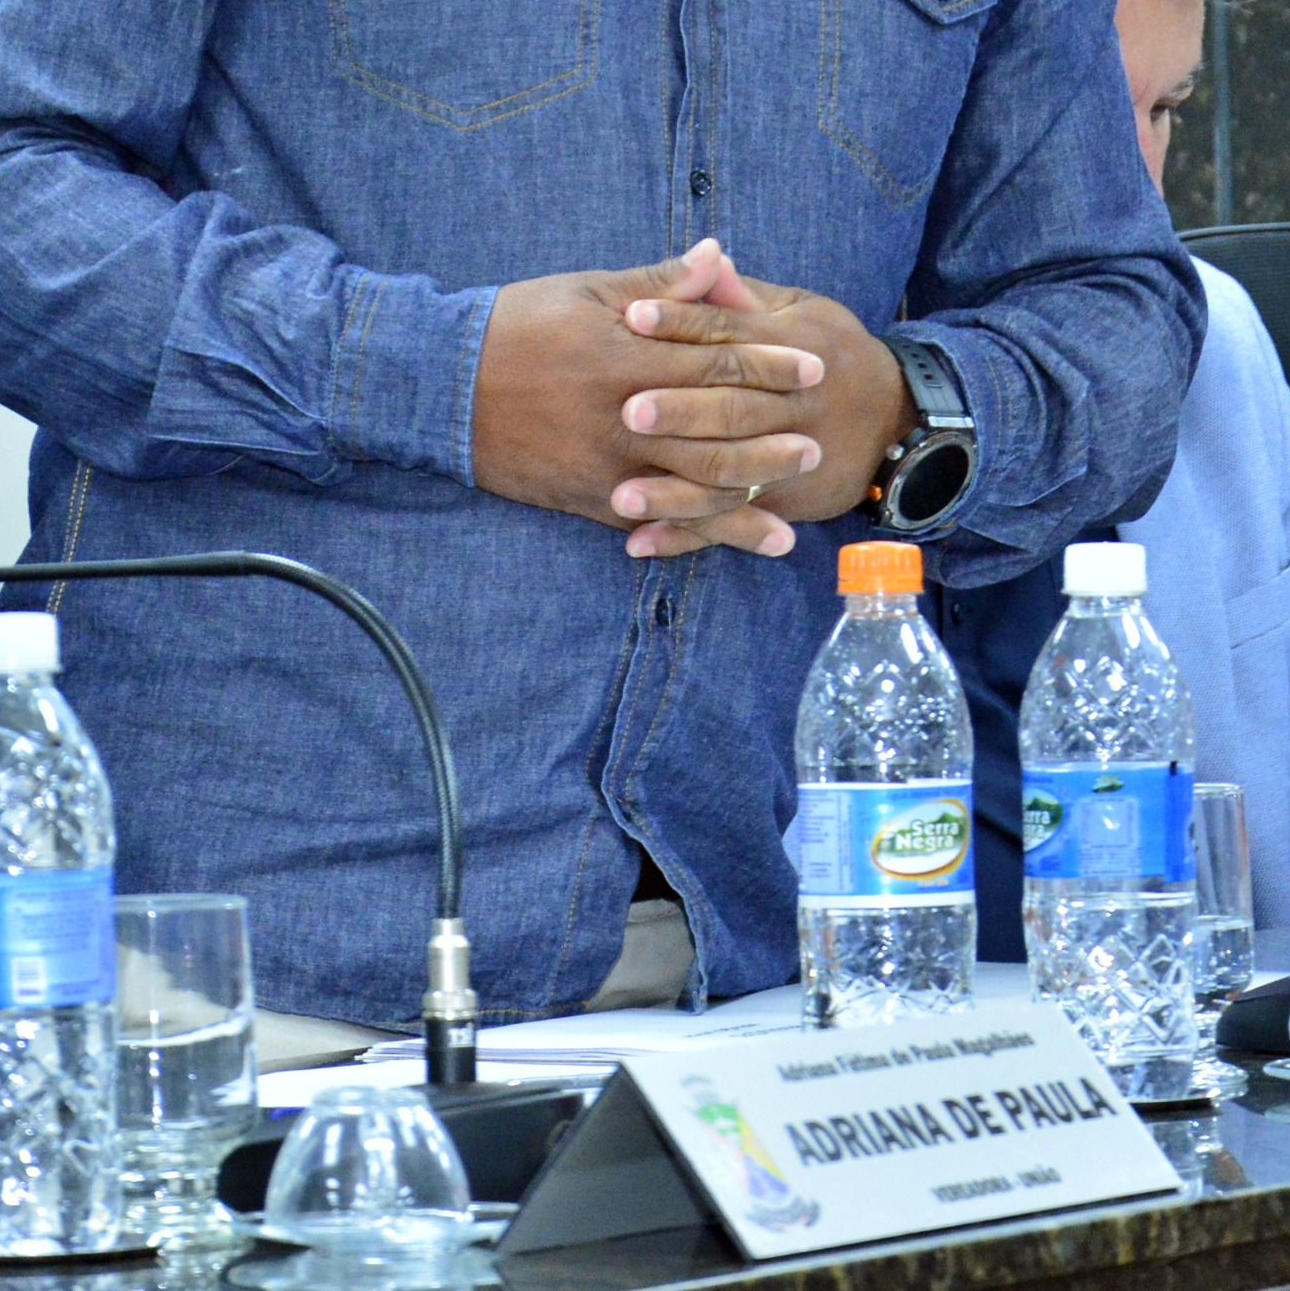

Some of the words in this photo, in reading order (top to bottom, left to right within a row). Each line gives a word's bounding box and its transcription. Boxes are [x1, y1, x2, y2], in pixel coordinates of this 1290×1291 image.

[1023, 810, 1051, 825] erra
[911, 819, 959, 837] Serra
[895, 832, 955, 852] Negra
[776, 1060, 839, 1082] Adriana
[890, 1047, 913, 1066] de
[909, 1041, 957, 1061] Paula
[784, 1102, 956, 1167] ADRIANA
[941, 1093, 1008, 1139] DE
[993, 1076, 1119, 1131] PAULA
